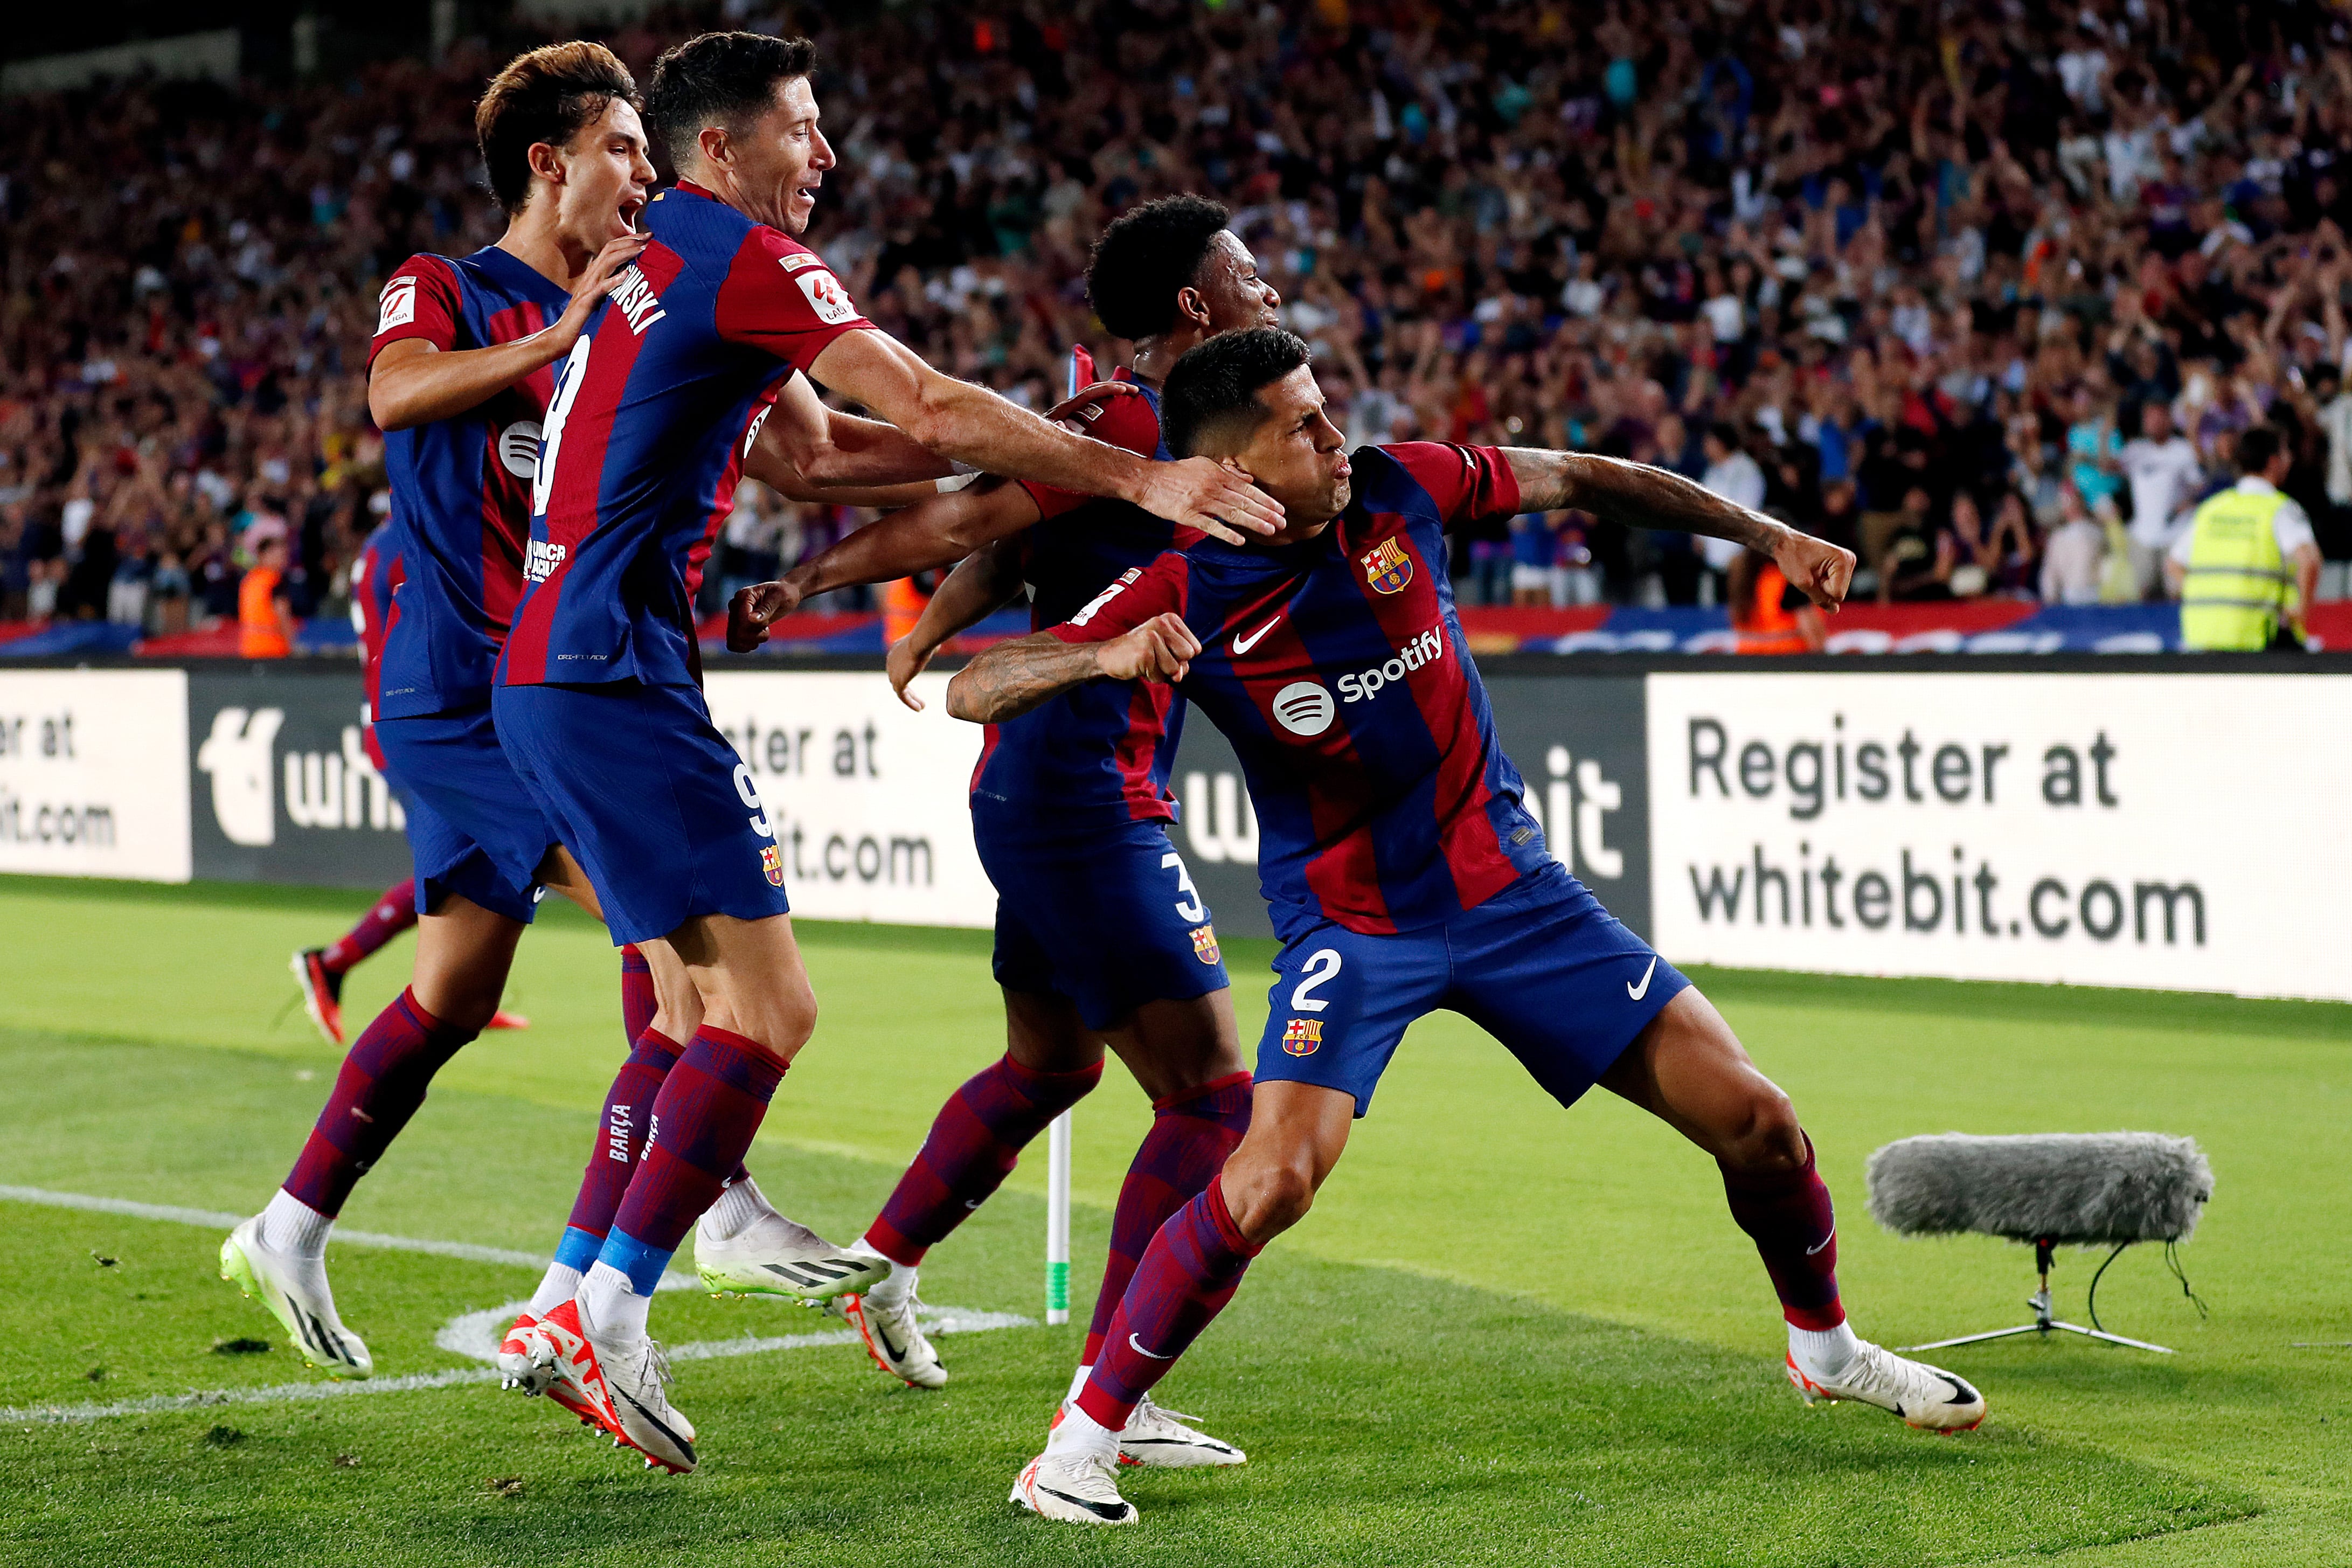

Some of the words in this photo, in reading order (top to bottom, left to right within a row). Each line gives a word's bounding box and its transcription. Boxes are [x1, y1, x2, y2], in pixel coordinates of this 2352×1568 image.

[1379, 561, 1396, 575] FCB
[1338, 626, 1442, 703] Spotify
[41, 710, 74, 758] at
[832, 721, 878, 778] at
[1687, 713, 2010, 822] Register
[2041, 730, 2119, 810] at
[733, 763, 772, 837] 9
[1161, 852, 1204, 922] 3
[1688, 840, 2207, 947] whitebit.com
[1291, 948, 1342, 1012] 2
[609, 1105, 633, 1163] BARÇA
